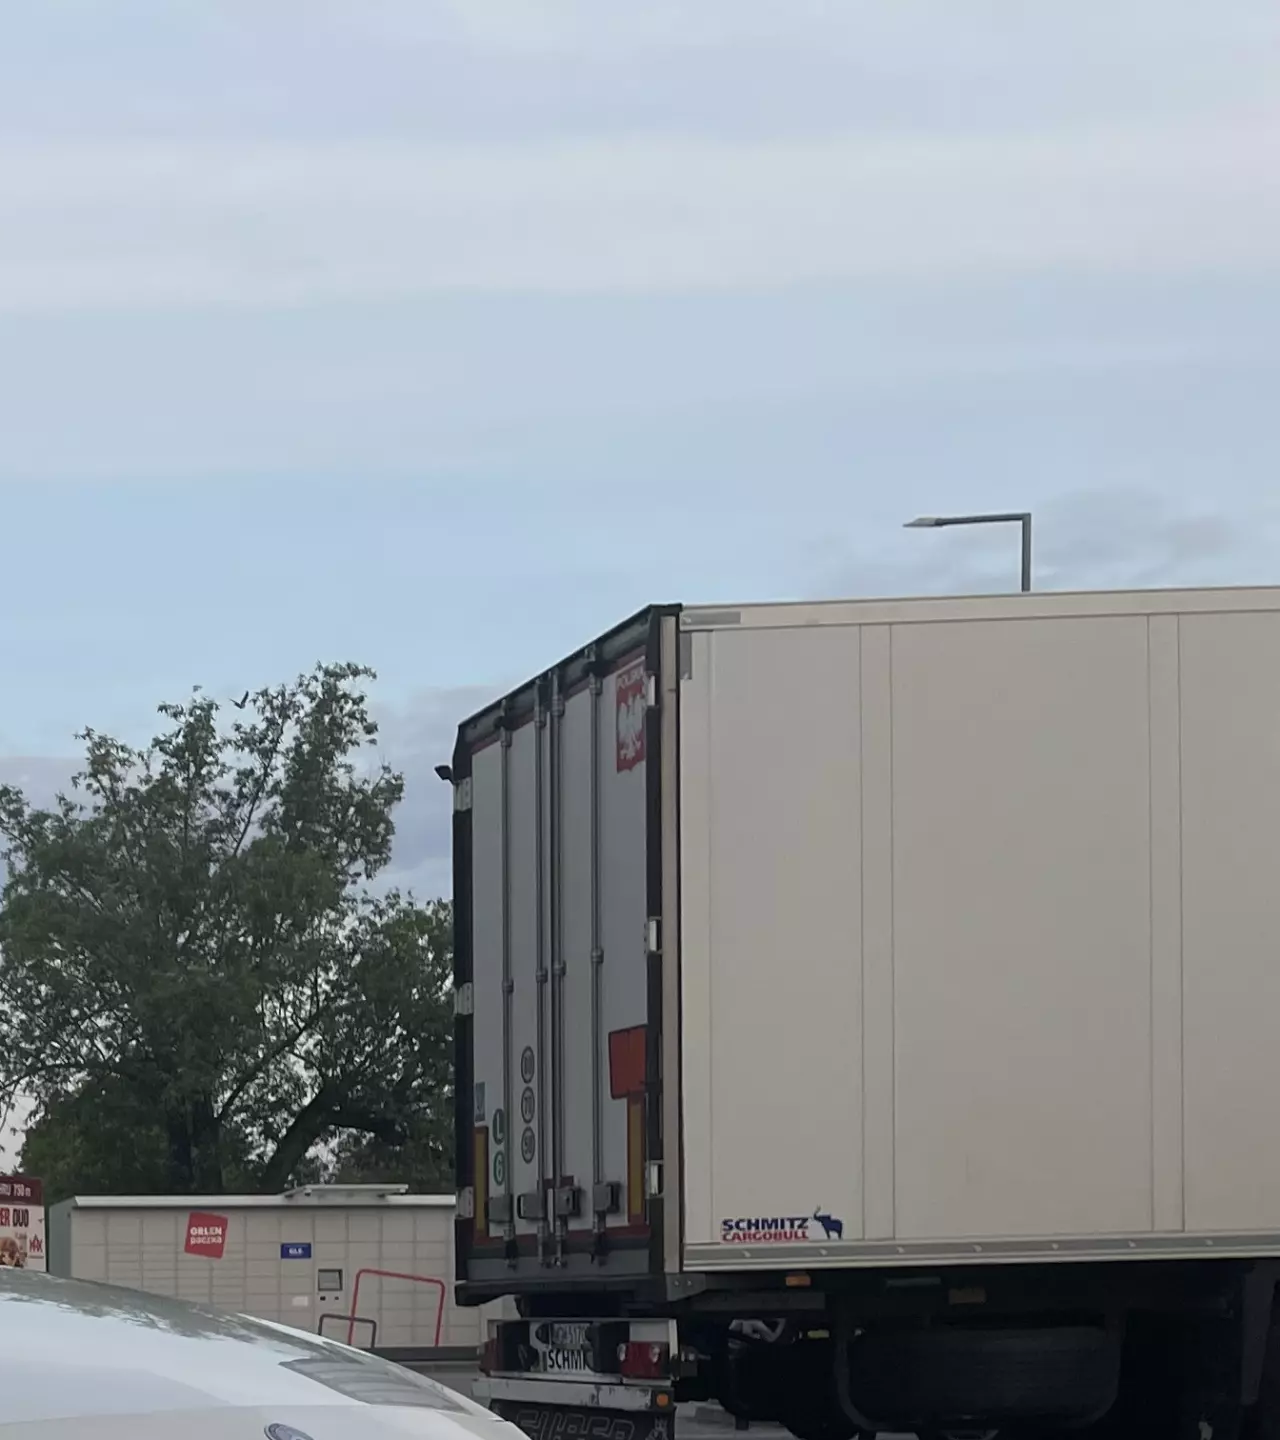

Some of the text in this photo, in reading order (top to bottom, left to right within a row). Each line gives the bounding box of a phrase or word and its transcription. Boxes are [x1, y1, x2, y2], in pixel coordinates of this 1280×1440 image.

[12, 1208, 29, 1228] DUO
[722, 1217, 809, 1231] SCHMITZ
[190, 1226, 222, 1236] ORLEN
[722, 1230, 809, 1243] CARGOBULL
[190, 1236, 222, 1245] paczka
[548, 1348, 586, 1371] SCHMI
